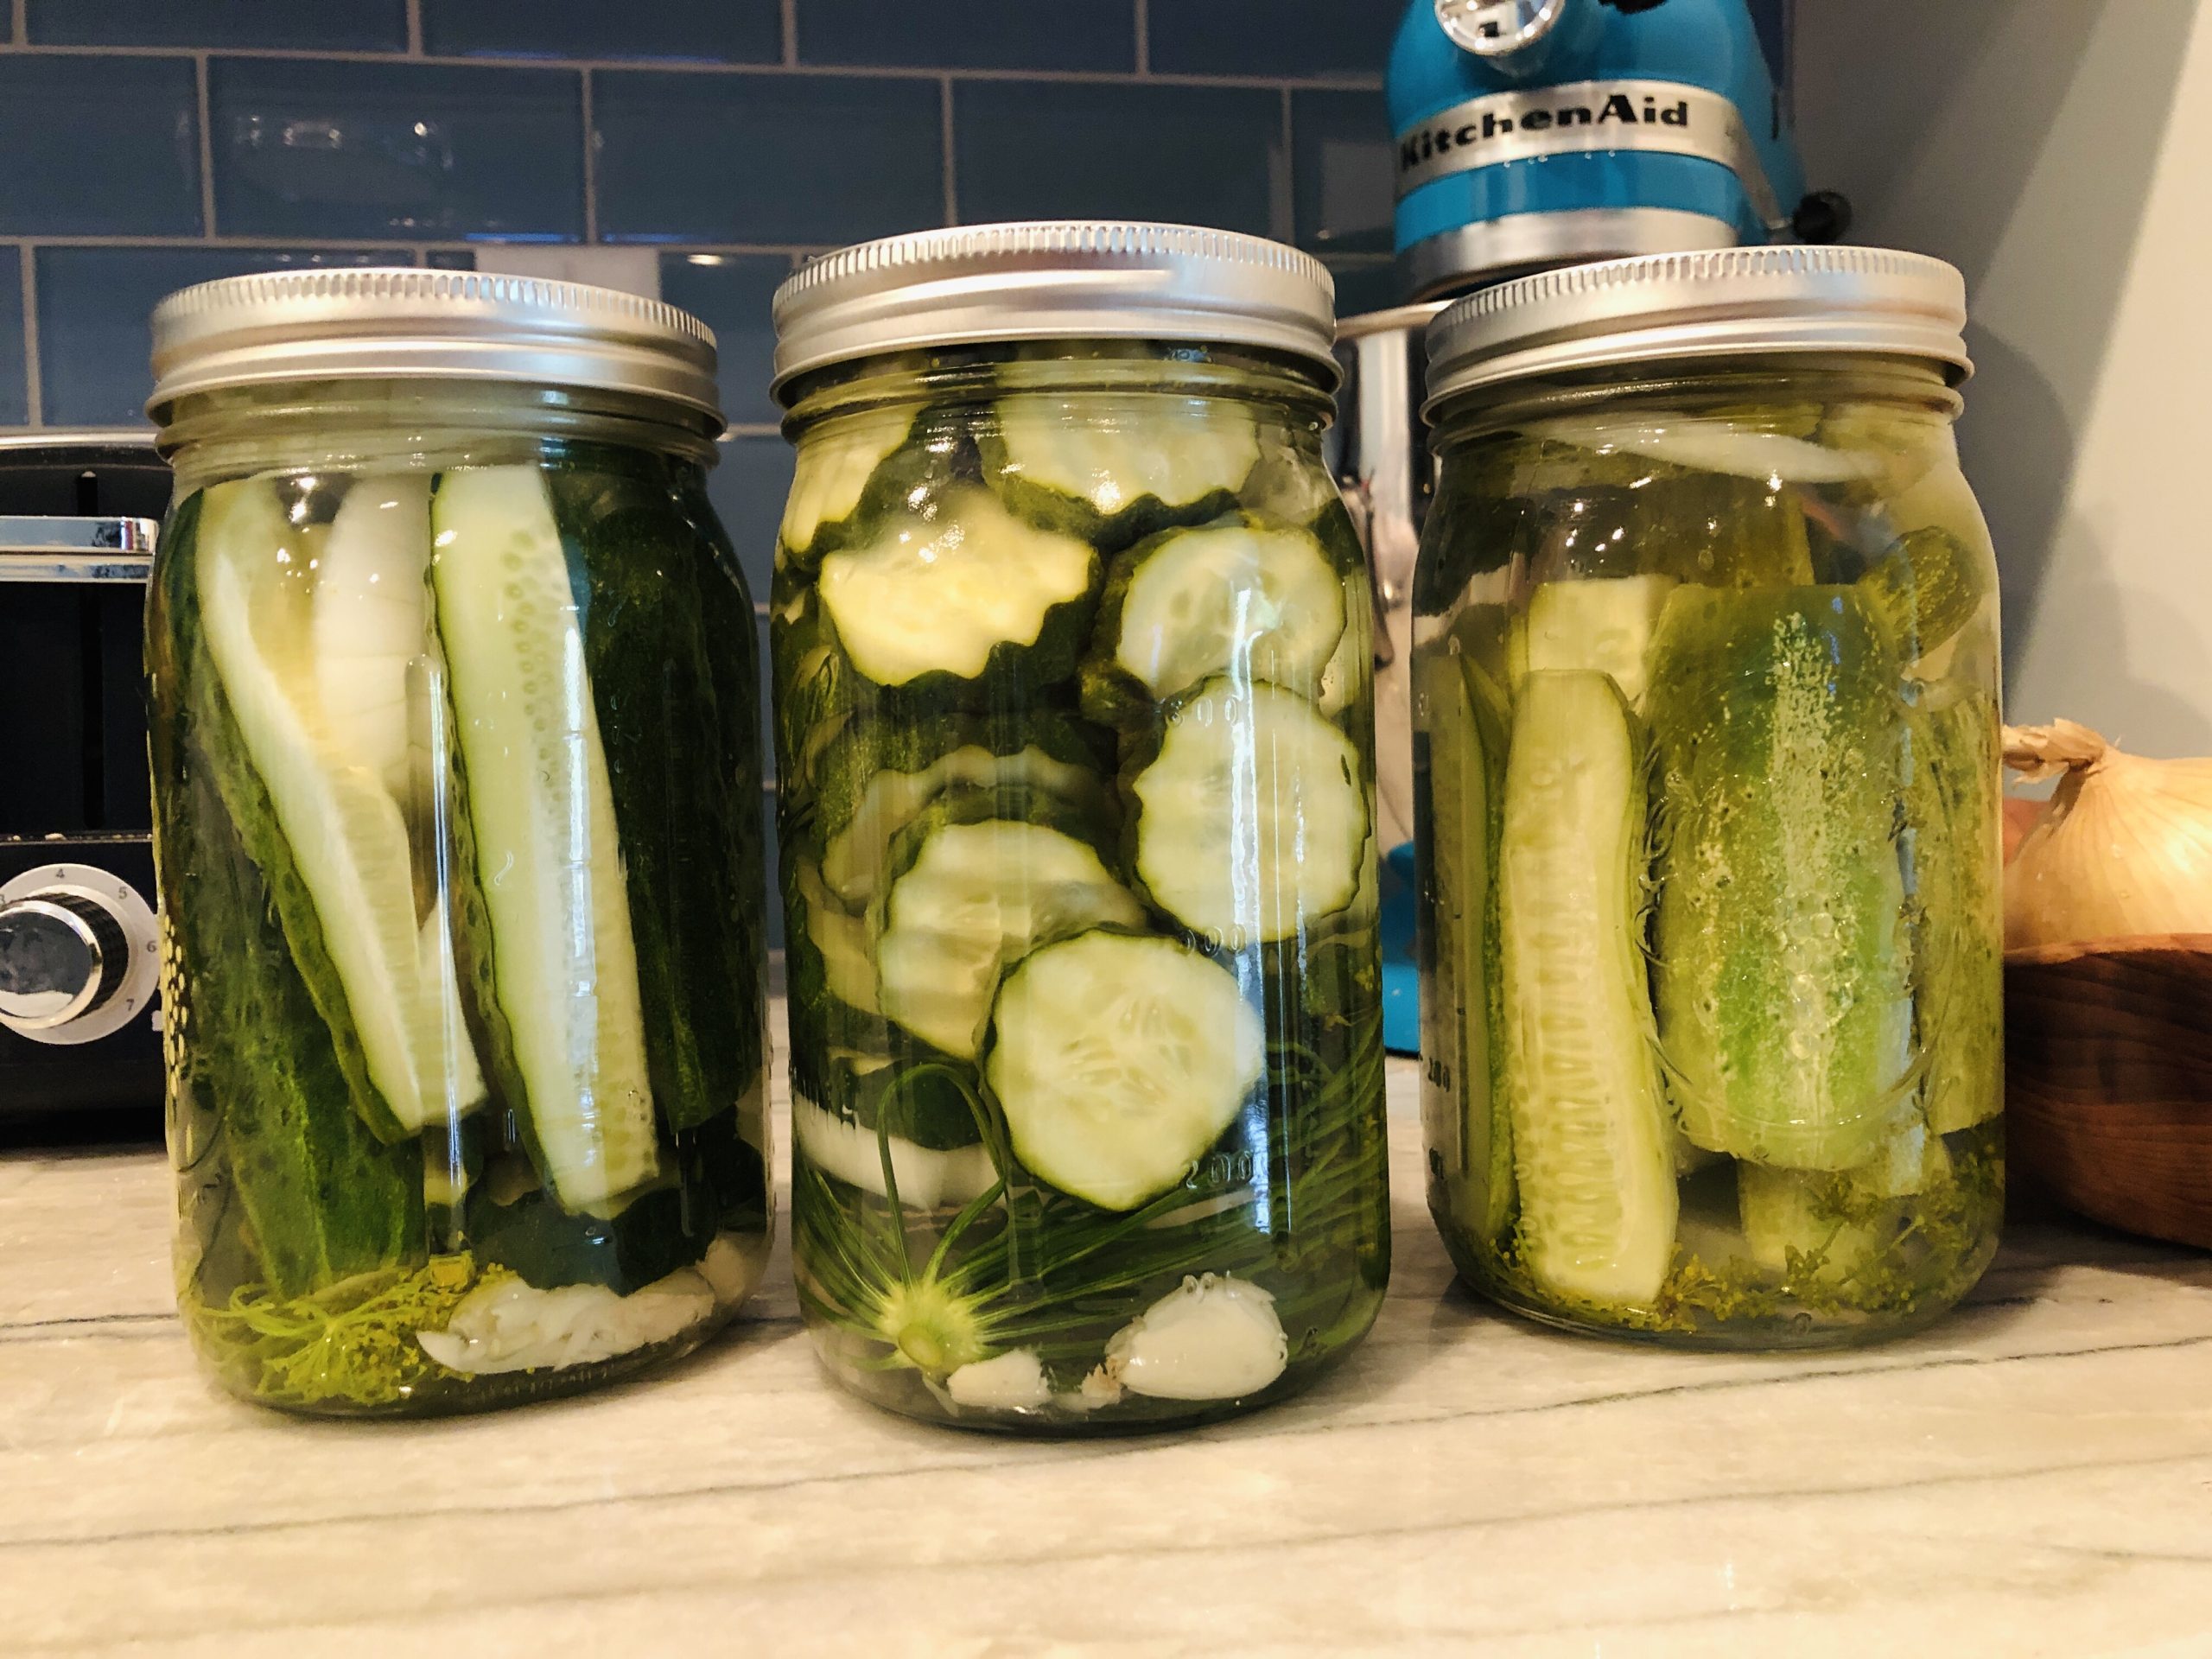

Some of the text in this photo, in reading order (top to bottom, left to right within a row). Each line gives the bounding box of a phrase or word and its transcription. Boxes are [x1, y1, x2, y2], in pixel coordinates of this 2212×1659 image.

[1400, 93, 1688, 171] KitchenAid
[55, 868, 65, 879] 4
[118, 886, 128, 899] 5
[147, 940, 157, 952] 6
[126, 999, 135, 1011] 7
